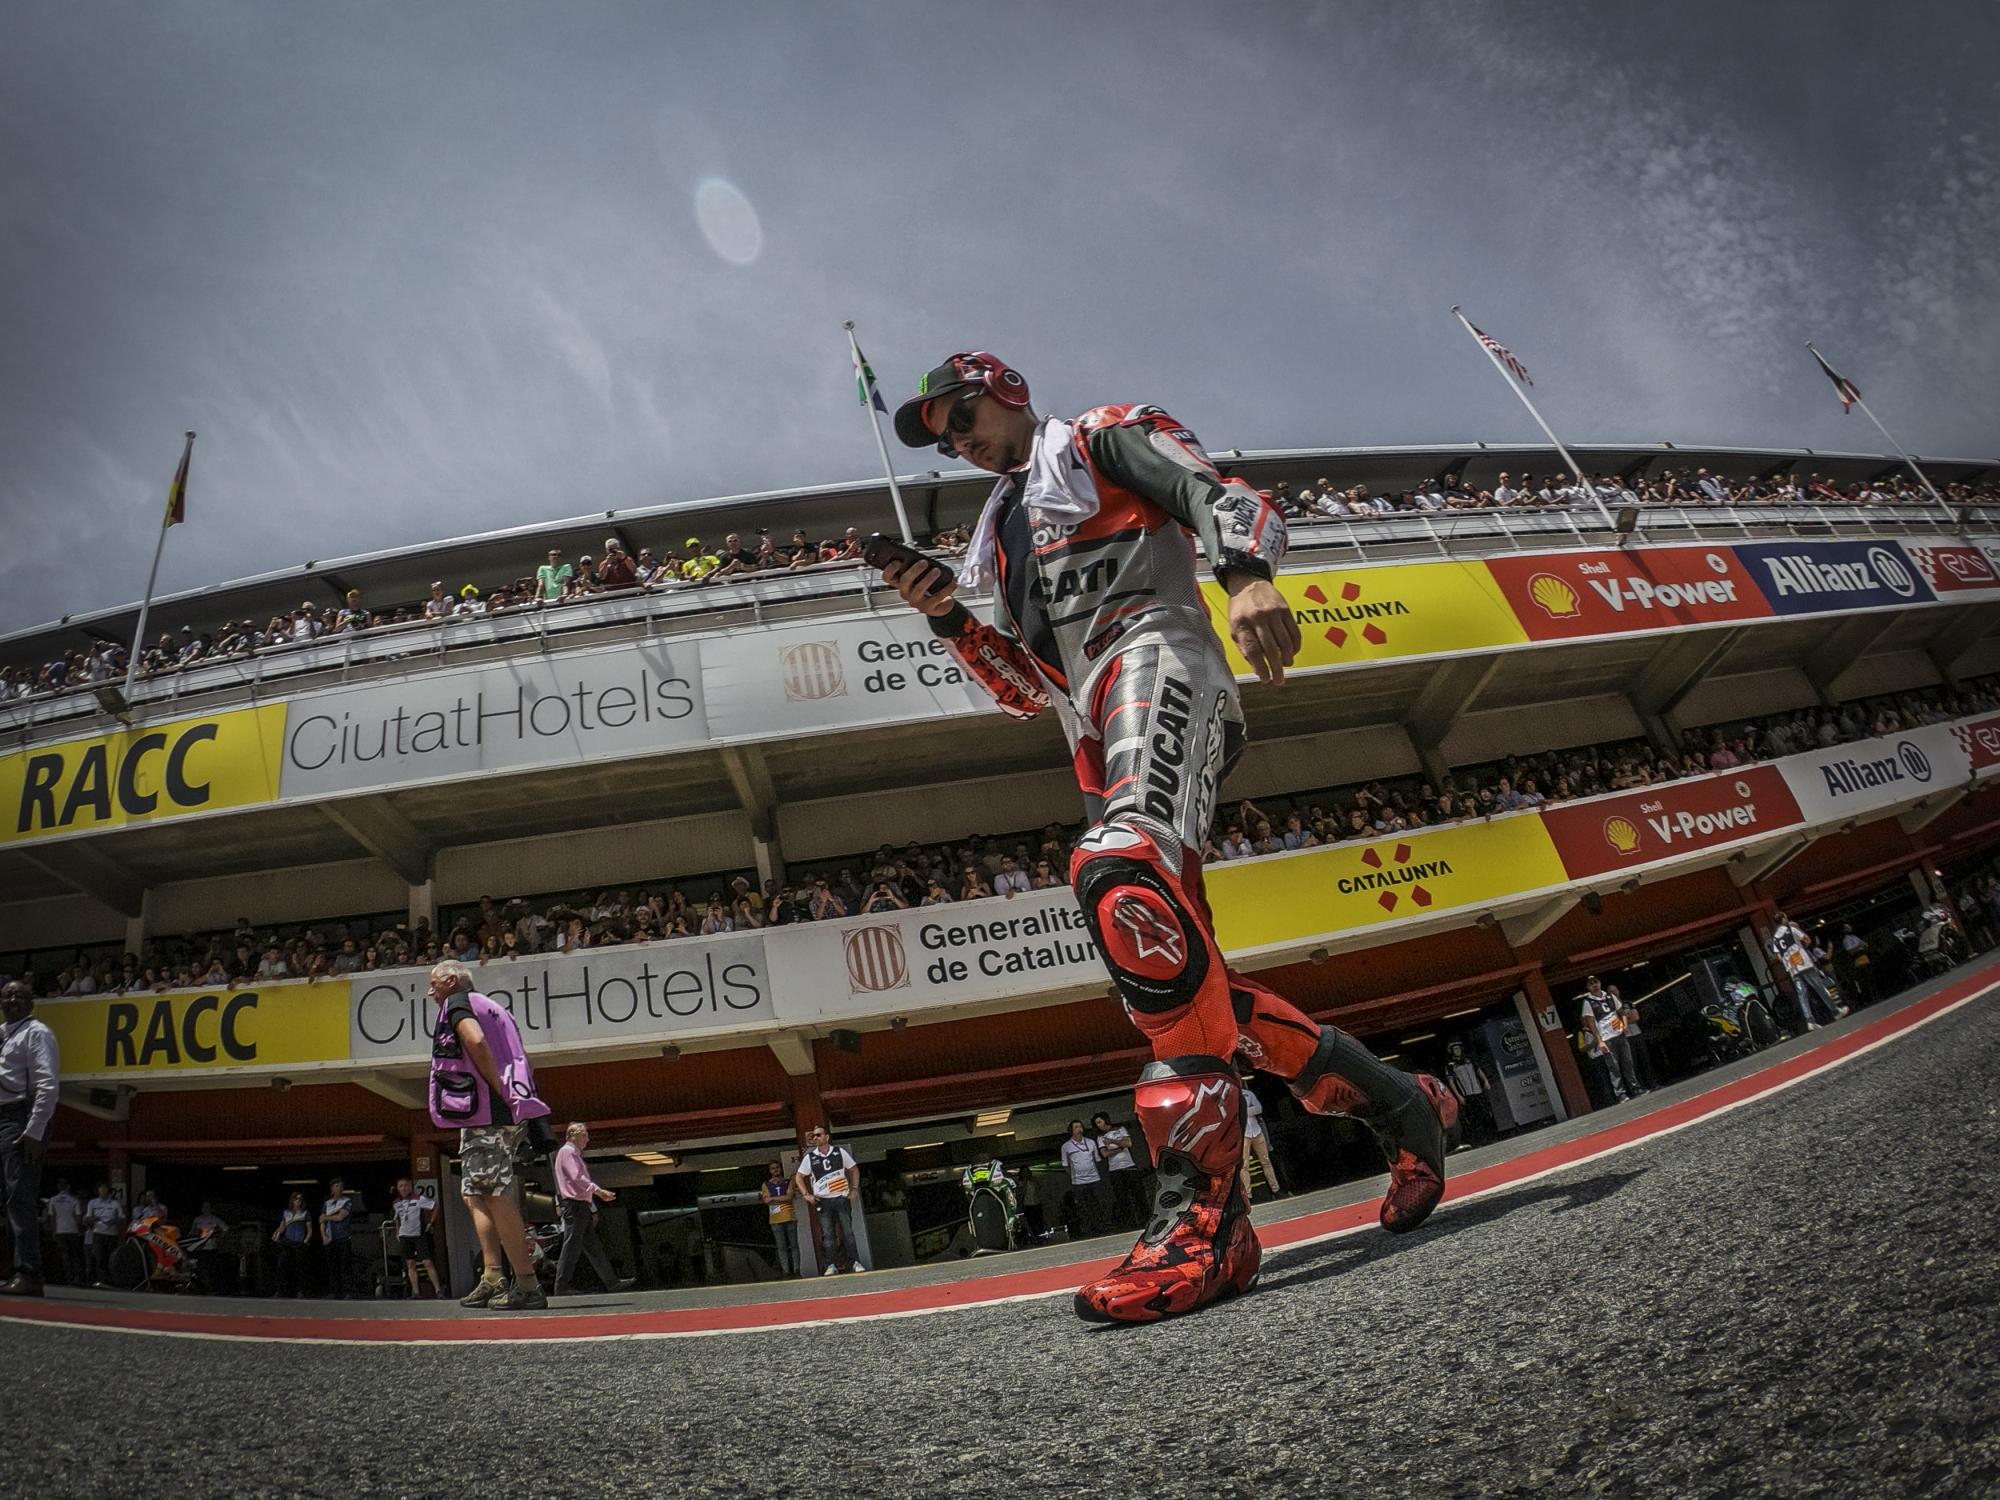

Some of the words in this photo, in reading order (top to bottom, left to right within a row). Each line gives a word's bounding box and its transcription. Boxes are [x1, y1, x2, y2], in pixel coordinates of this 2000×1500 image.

[1578, 561, 1611, 575] Shell
[1761, 555, 1881, 596] Allianz
[1588, 576, 1739, 612] V-Power
[1296, 601, 1410, 625] ATALUNYA
[857, 639, 948, 663] Gene
[864, 669, 907, 694] de
[917, 664, 974, 687] Ca
[290, 669, 694, 771] CiutatHotels
[1144, 675, 1194, 826] DUCATI
[16, 723, 219, 833] RACC
[1819, 757, 1905, 797] Allianz
[1640, 800, 1664, 814] Shell
[1647, 803, 1757, 844] V-Power
[1337, 859, 1454, 895] CATALUNYA
[919, 907, 1087, 950] Generalita
[927, 957, 968, 985] de
[105, 992, 259, 1067] RACC
[1541, 1011, 1556, 1026] 17
[822, 1158, 832, 1171] C
